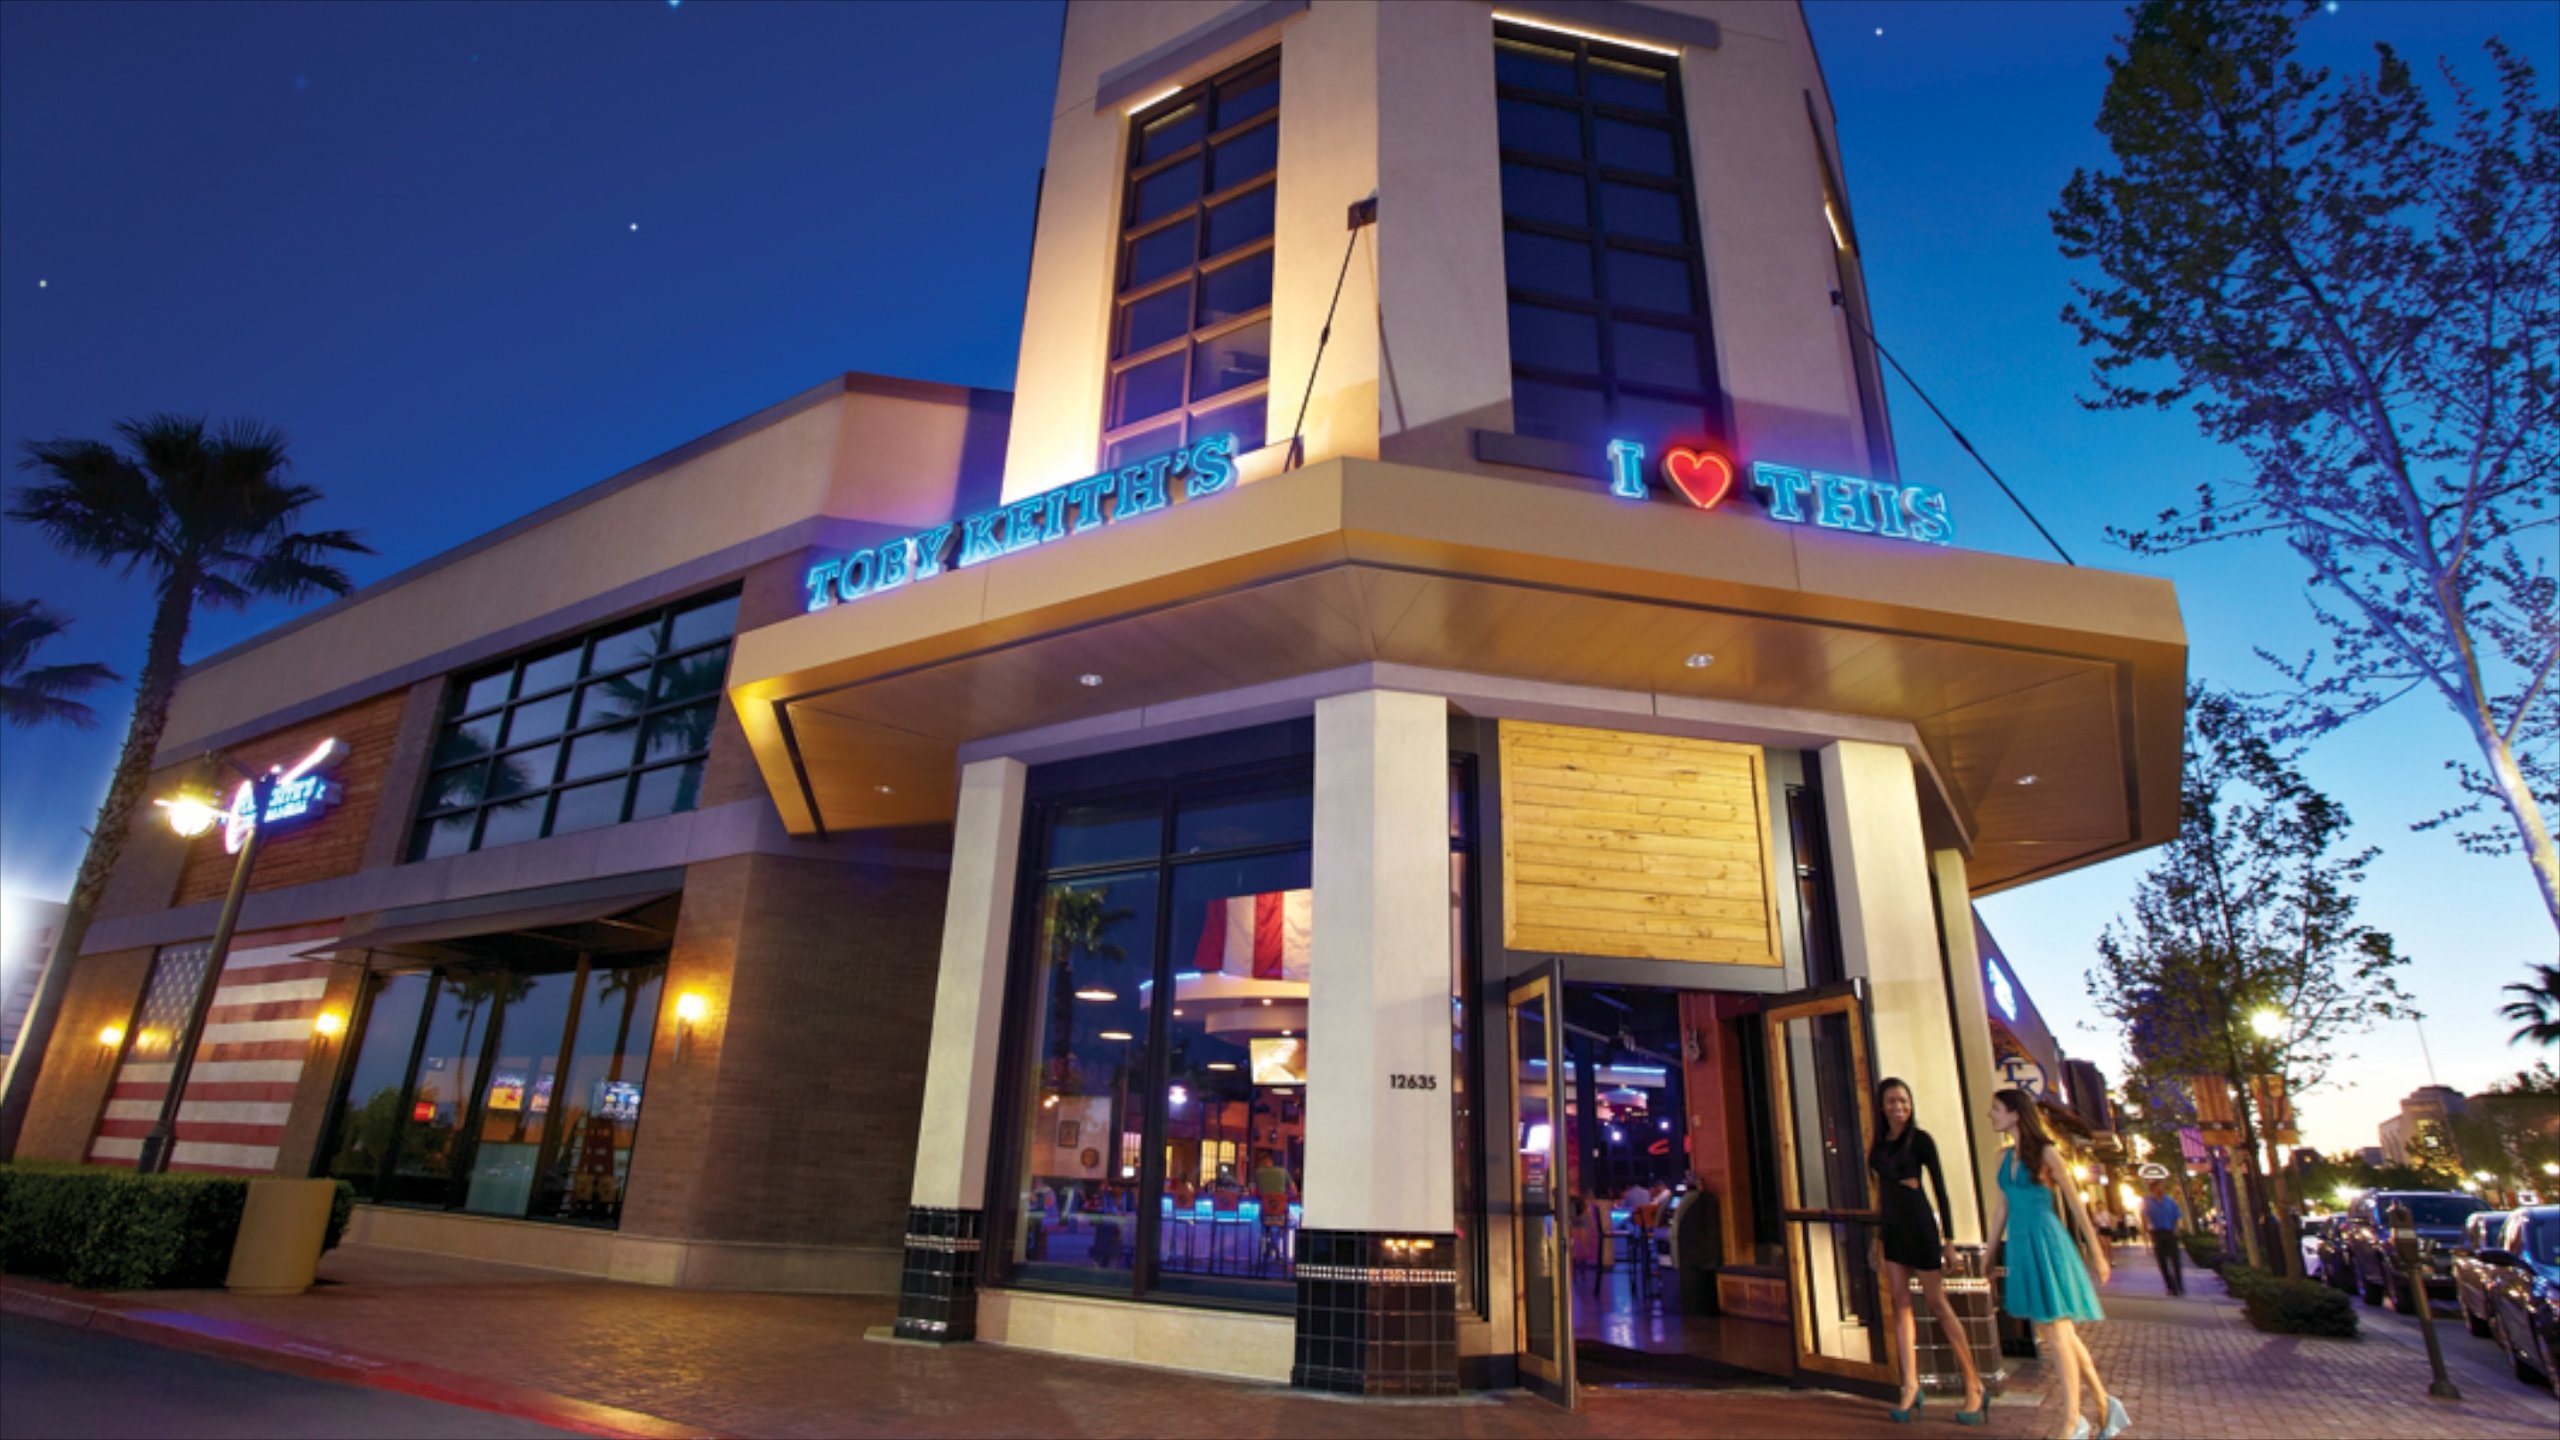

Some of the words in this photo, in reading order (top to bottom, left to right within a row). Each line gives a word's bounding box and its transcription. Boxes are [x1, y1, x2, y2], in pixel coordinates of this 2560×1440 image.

[806, 521, 954, 612] TOBY
[958, 433, 1238, 567] KEITH'S
[1606, 438, 1645, 499] I
[1753, 461, 1953, 546] THIS
[1390, 1074, 1437, 1091] 12635
